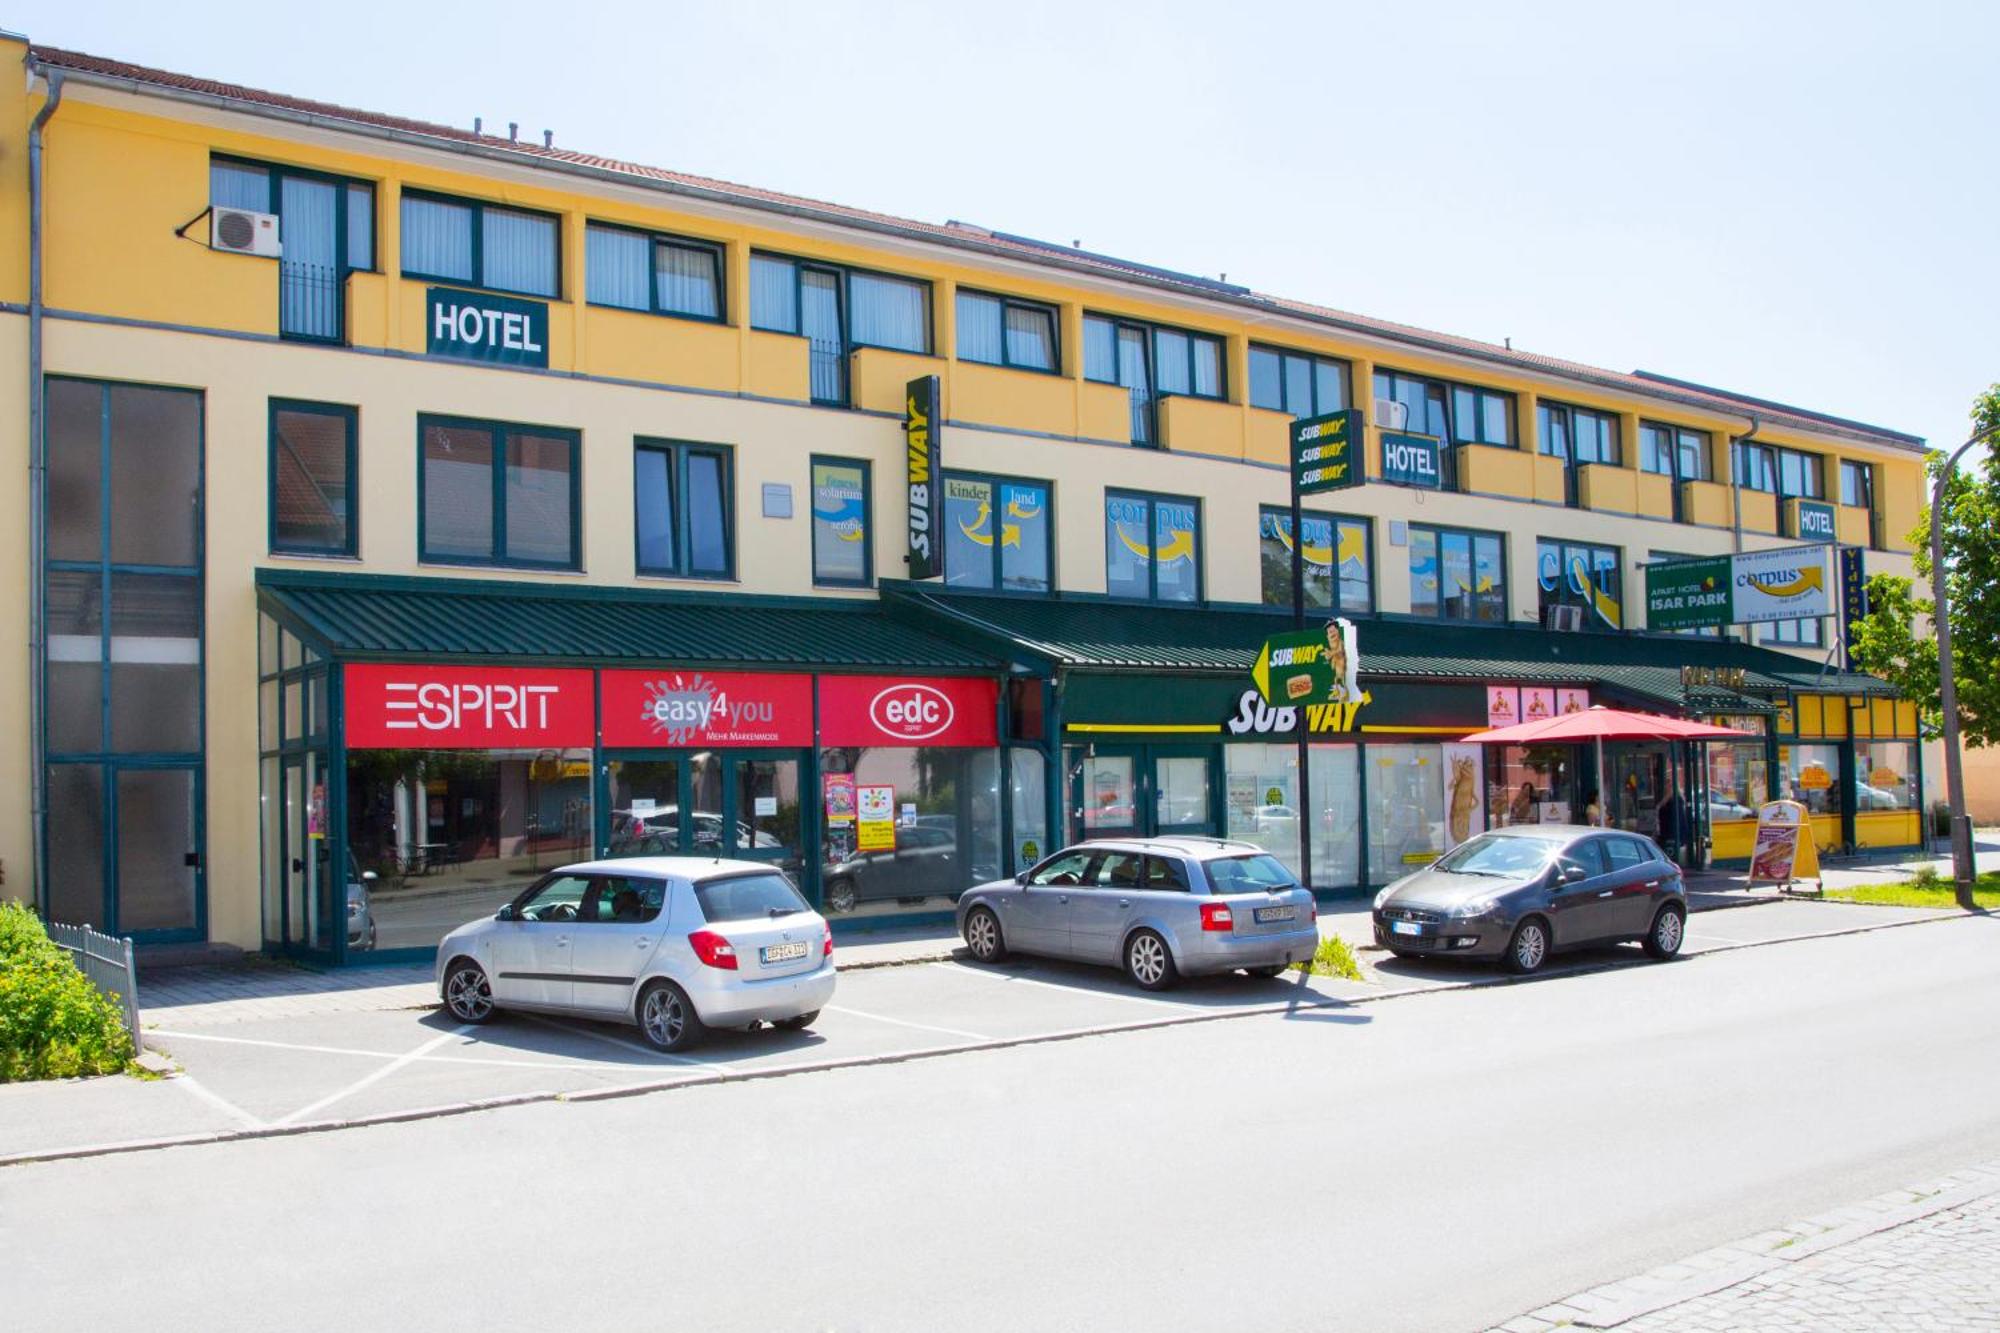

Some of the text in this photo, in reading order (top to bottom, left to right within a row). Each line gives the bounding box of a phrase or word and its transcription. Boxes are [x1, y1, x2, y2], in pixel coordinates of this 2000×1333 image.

[435, 302, 542, 352] HOTEL
[1298, 417, 1346, 442] SUBWAY
[1299, 440, 1347, 463] SUBWAY
[1385, 443, 1436, 475] HOTEL
[908, 396, 930, 561] SUBWAY
[1300, 463, 1348, 485] SUBWAY
[819, 486, 863, 500] solarium
[949, 482, 1036, 505] kinder land
[1801, 510, 1833, 534] HOTEL
[1736, 569, 1797, 588] corpus
[1651, 592, 1727, 610] ISAR PARK
[1269, 644, 1324, 667] SUBWAY
[385, 683, 559, 730] ESPRIT
[654, 692, 773, 731] easy4you
[886, 693, 940, 723] edc
